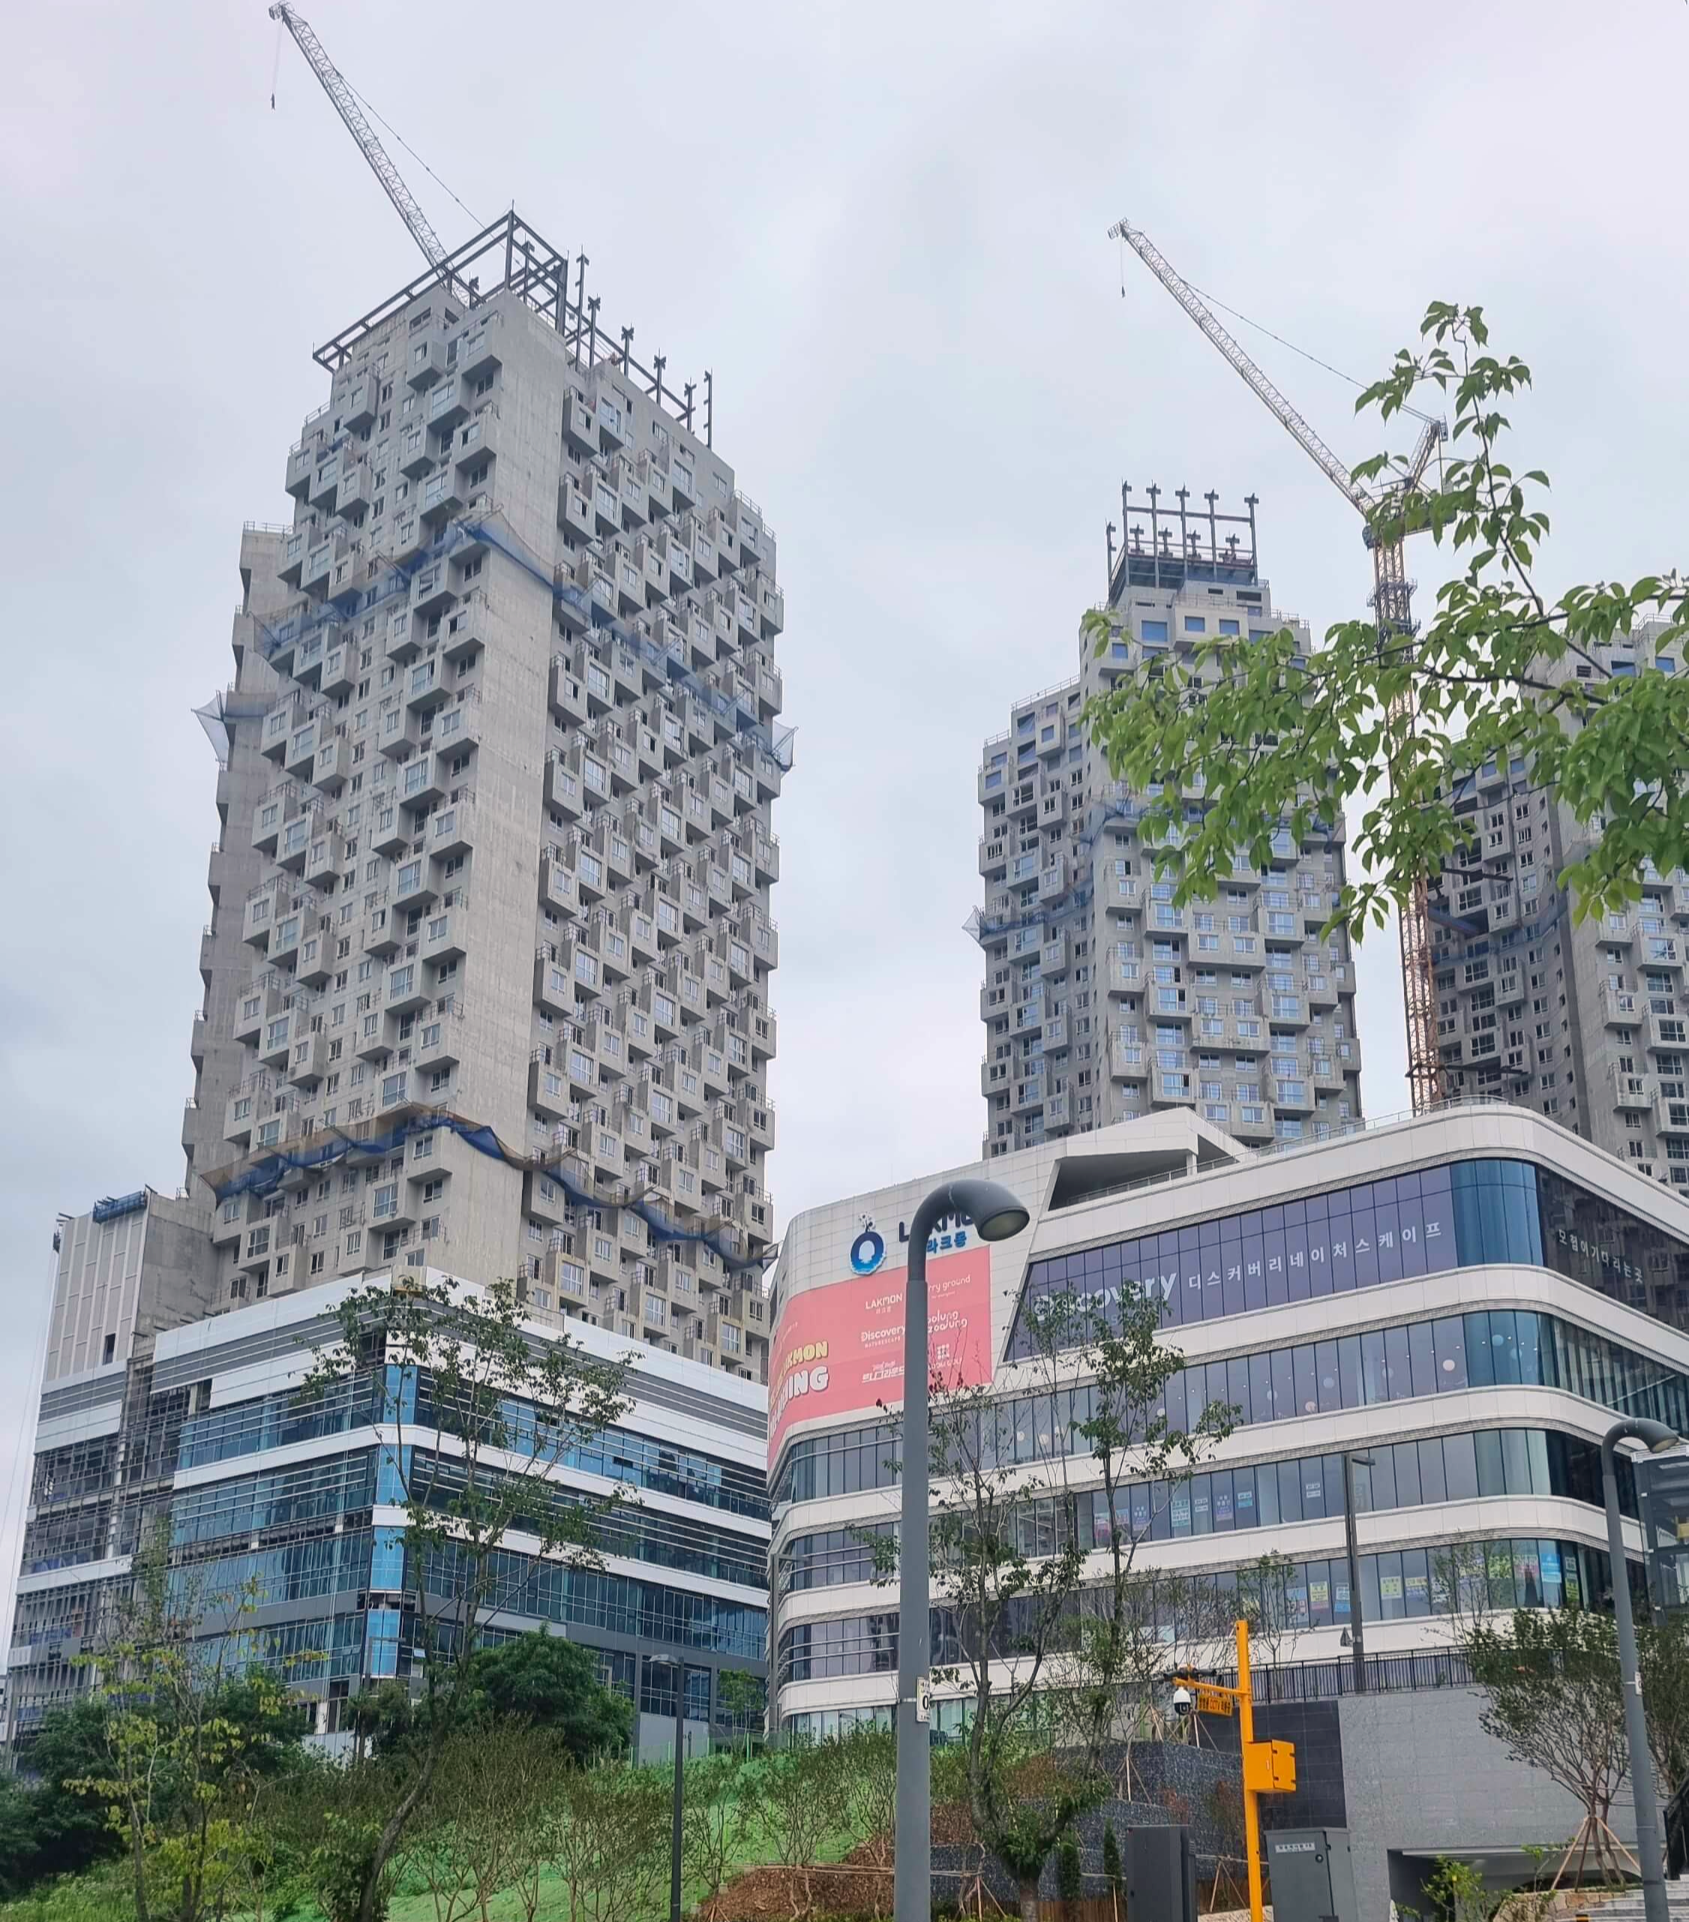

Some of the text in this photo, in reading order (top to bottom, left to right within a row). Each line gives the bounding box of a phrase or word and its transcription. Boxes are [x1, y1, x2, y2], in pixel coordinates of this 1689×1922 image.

[942, 1274, 971, 1292] ground
[865, 1292, 903, 1310] LAKMON
[861, 1325, 906, 1343] Discovery
